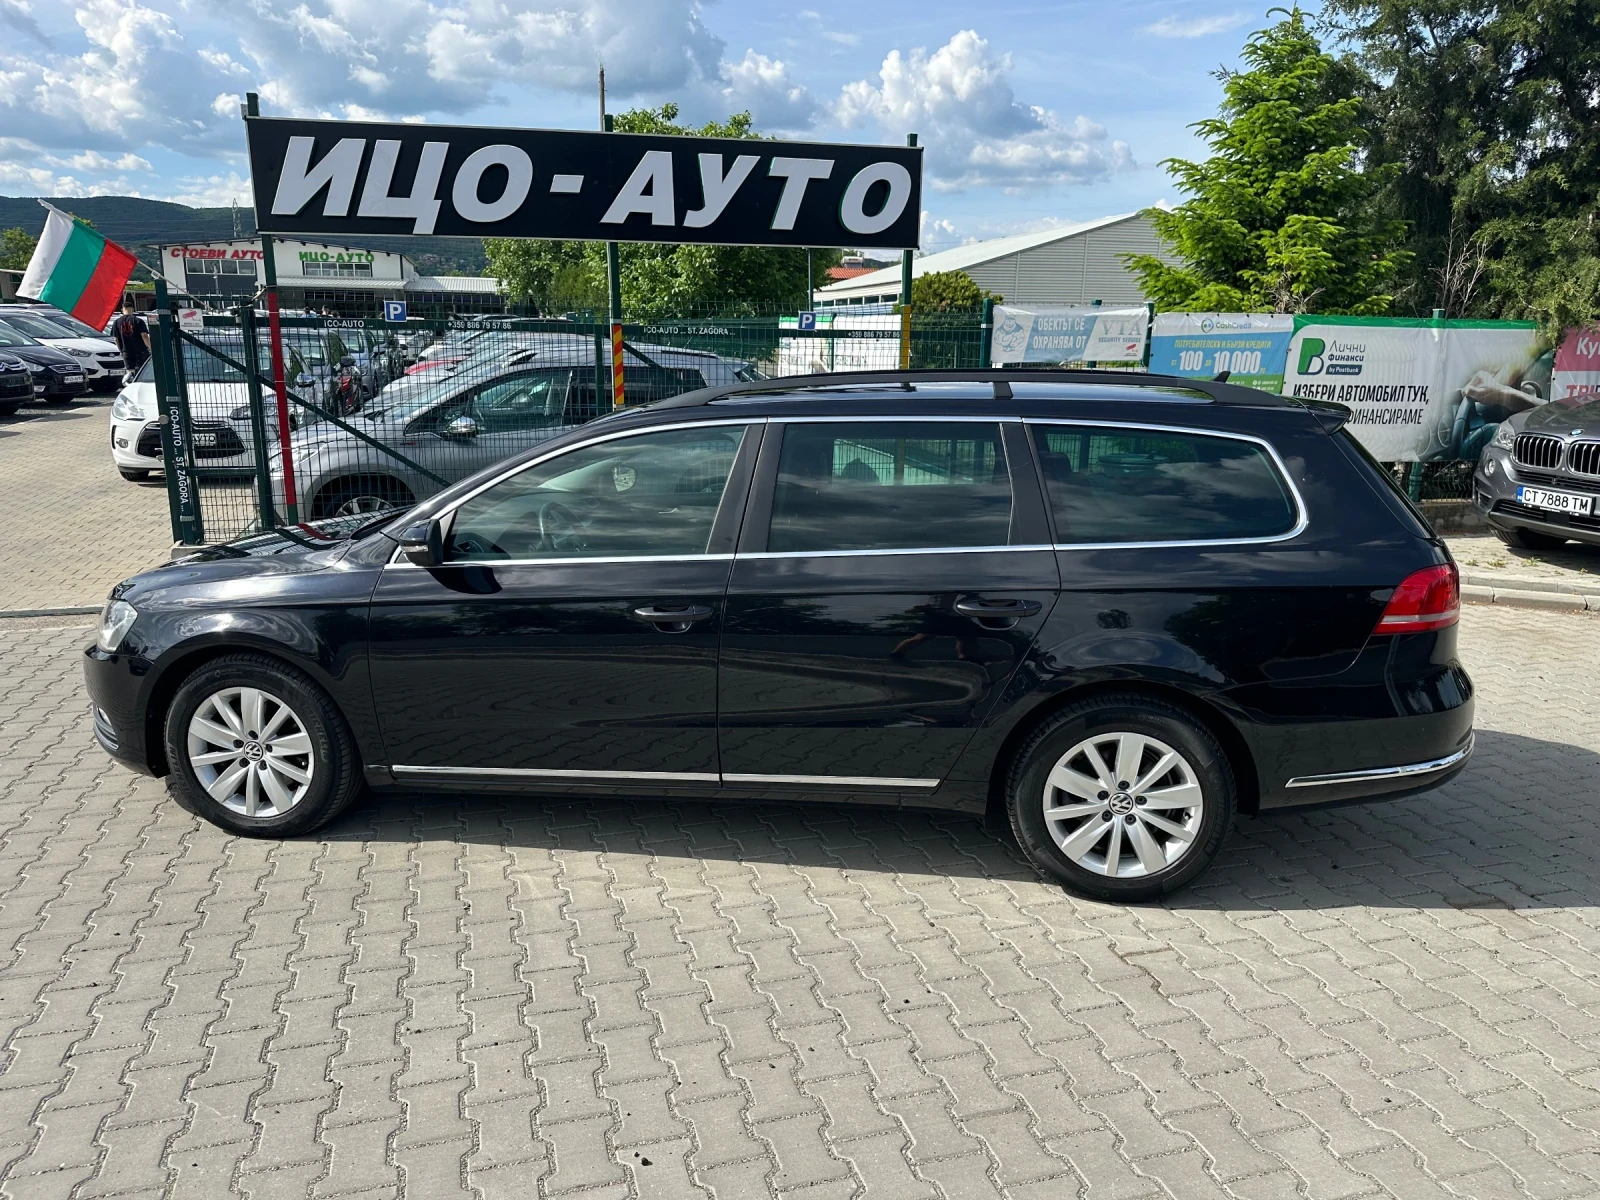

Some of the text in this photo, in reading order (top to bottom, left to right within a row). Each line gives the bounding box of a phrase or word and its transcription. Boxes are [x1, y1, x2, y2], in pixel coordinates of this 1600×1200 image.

[271, 136, 533, 234] ИЦО
[600, 149, 911, 234] АУТО
[171, 247, 264, 260] СТОЕВИ АУТО
[299, 251, 375, 263] ИЦО-АУТО
[389, 304, 402, 320] P
[493, 322, 501, 330] 57
[801, 314, 813, 329] P
[1037, 317, 1085, 331] ОБЕКТЪТ СЕ
[1101, 319, 1142, 335] VTA
[1215, 320, 1252, 329] CashCredit
[699, 327, 729, 336] ZAGORA
[1033, 335, 1087, 349] ОХРАНЯВА ОТ
[1329, 340, 1366, 353] Лични
[1179, 350, 1204, 371] 100
[1293, 383, 1429, 405] ИЗБЕРИ АВТОМОБИЛ ТУК,
[177, 469, 189, 504] ZAGORA
[1524, 489, 1589, 512] CT 7888 TM
